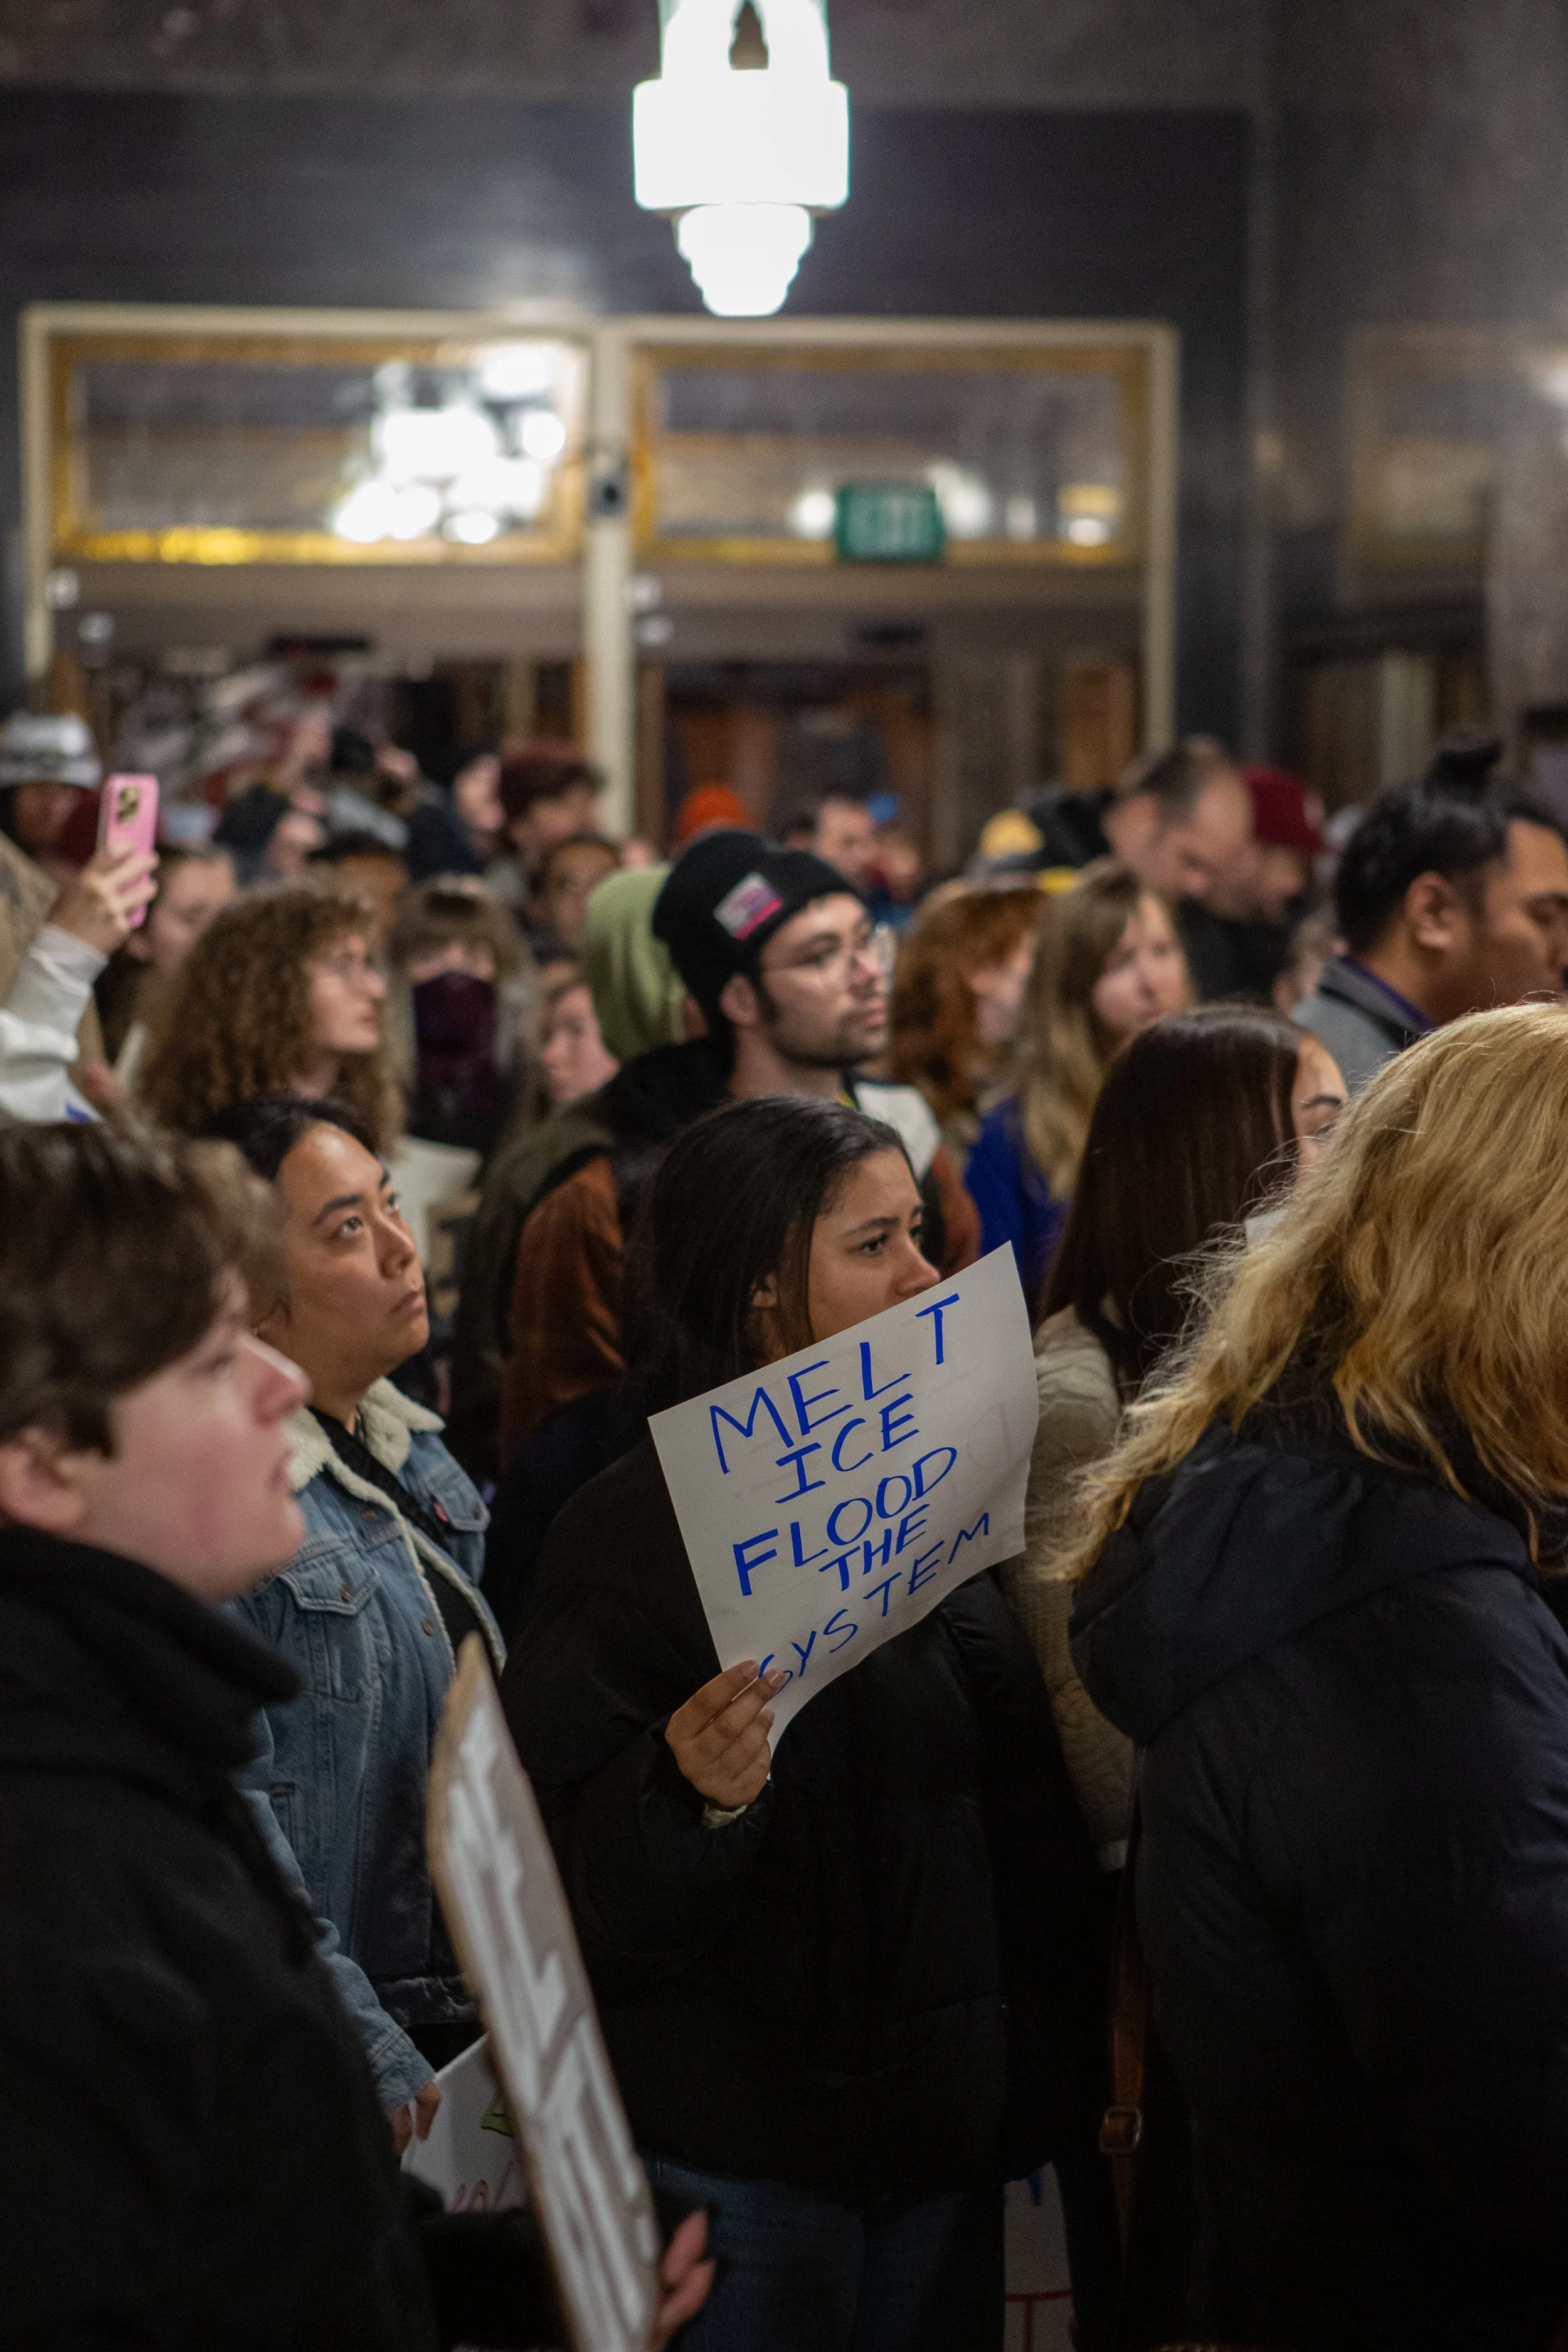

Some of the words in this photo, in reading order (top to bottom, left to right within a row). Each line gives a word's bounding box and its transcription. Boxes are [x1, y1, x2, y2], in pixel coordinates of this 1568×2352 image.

[709, 1293, 960, 1474] MELT
[775, 1392, 920, 1504] ICE
[733, 1446, 958, 1596] FLOOD
[818, 1503, 931, 1592] THE
